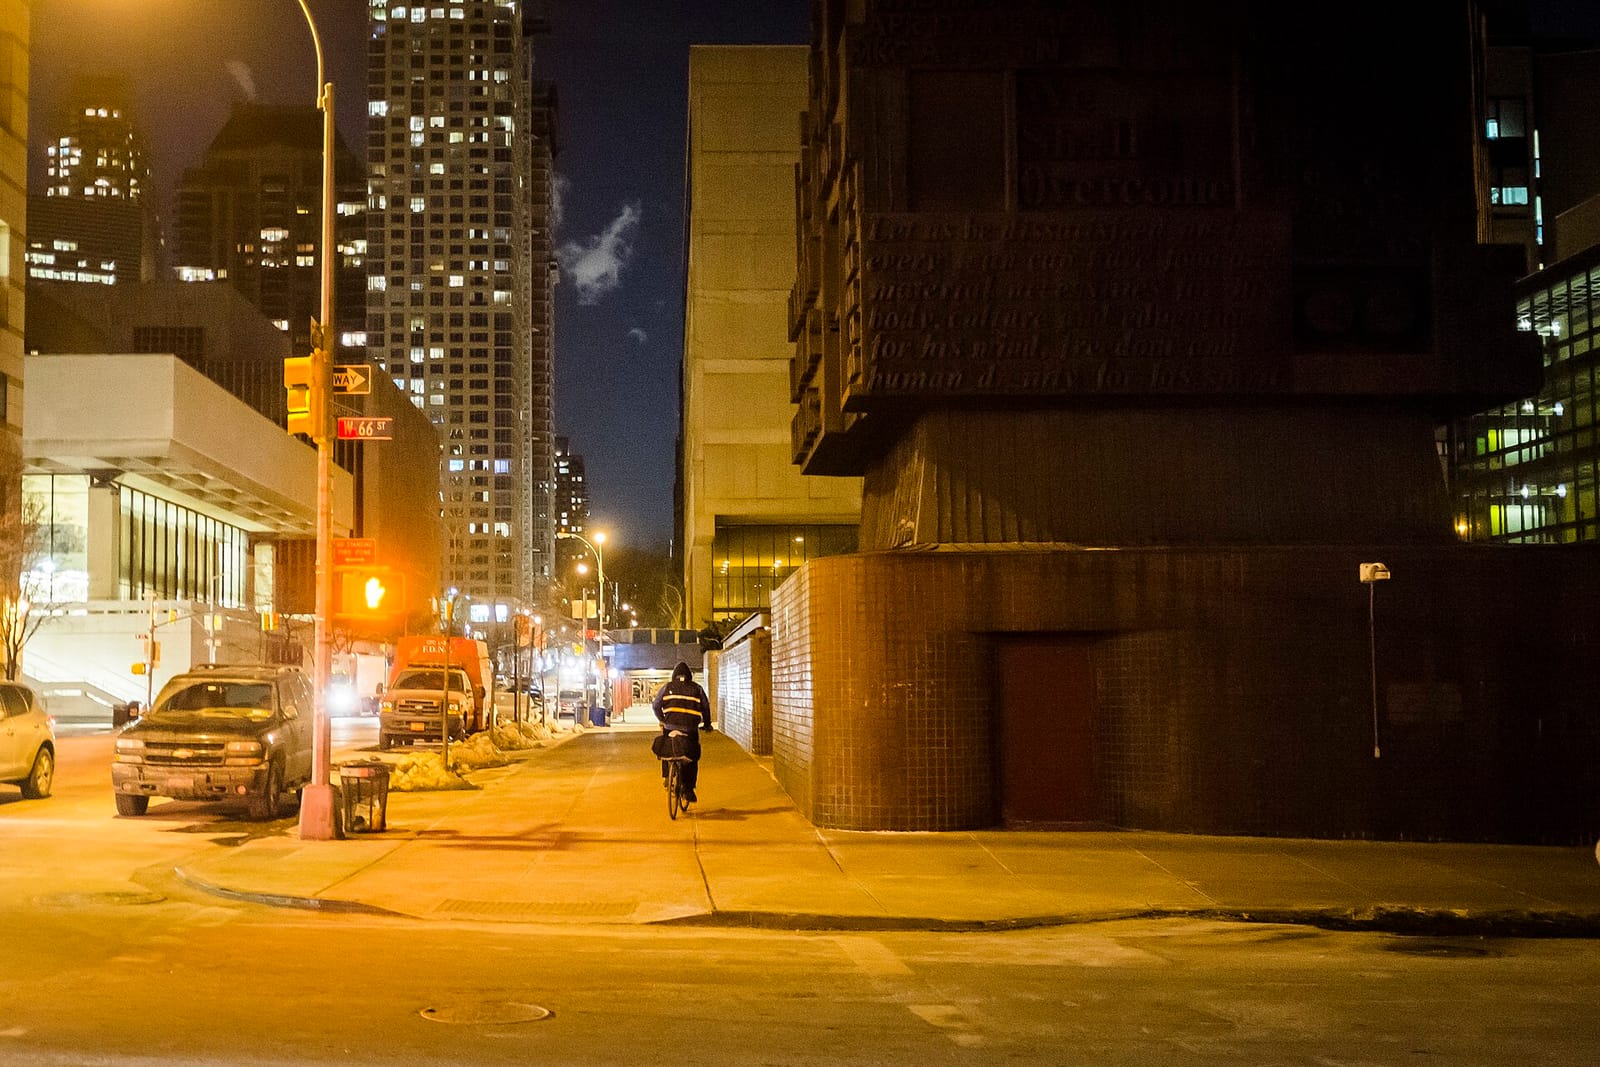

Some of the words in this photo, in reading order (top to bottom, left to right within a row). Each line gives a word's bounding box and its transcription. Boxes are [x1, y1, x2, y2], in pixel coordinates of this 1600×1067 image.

[870, 333, 912, 362] for
[921, 334, 961, 358] his
[334, 375, 357, 385] WAY
[867, 365, 963, 390] human
[978, 364, 1080, 391] dnity
[343, 420, 354, 435] W
[359, 421, 373, 436] 66
[377, 422, 386, 430] ST
